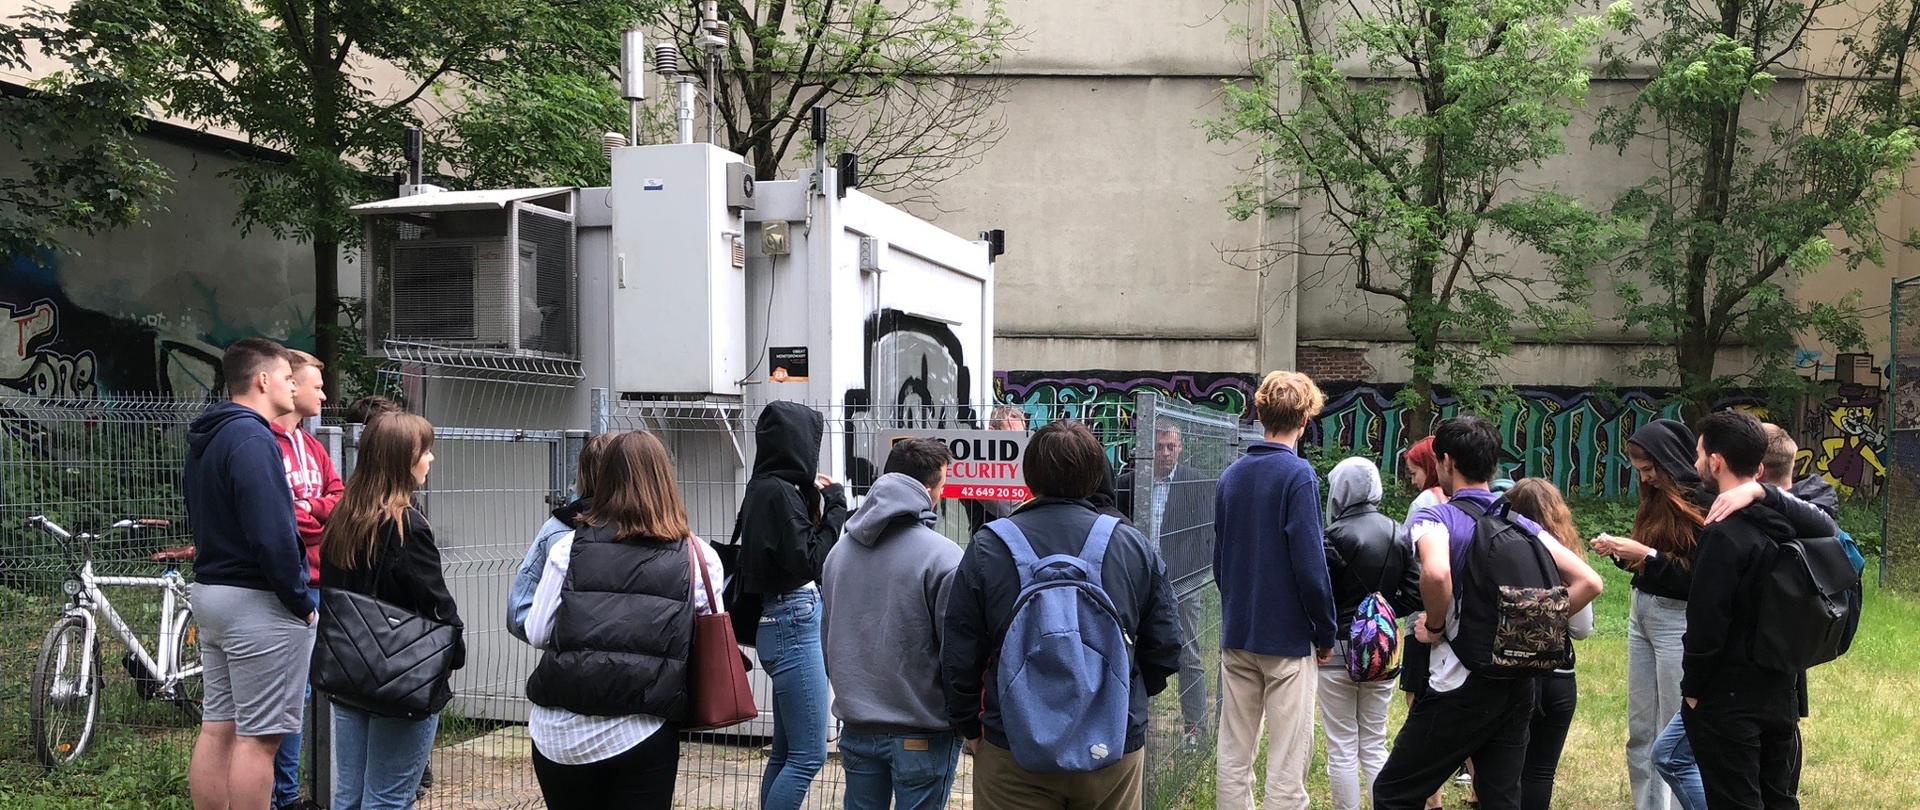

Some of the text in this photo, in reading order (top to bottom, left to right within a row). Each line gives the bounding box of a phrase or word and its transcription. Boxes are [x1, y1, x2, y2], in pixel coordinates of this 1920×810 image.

[938, 438, 1019, 461] OLID
[946, 462, 1018, 479] ECURITY
[961, 487, 1024, 498] 42 649 20 50
